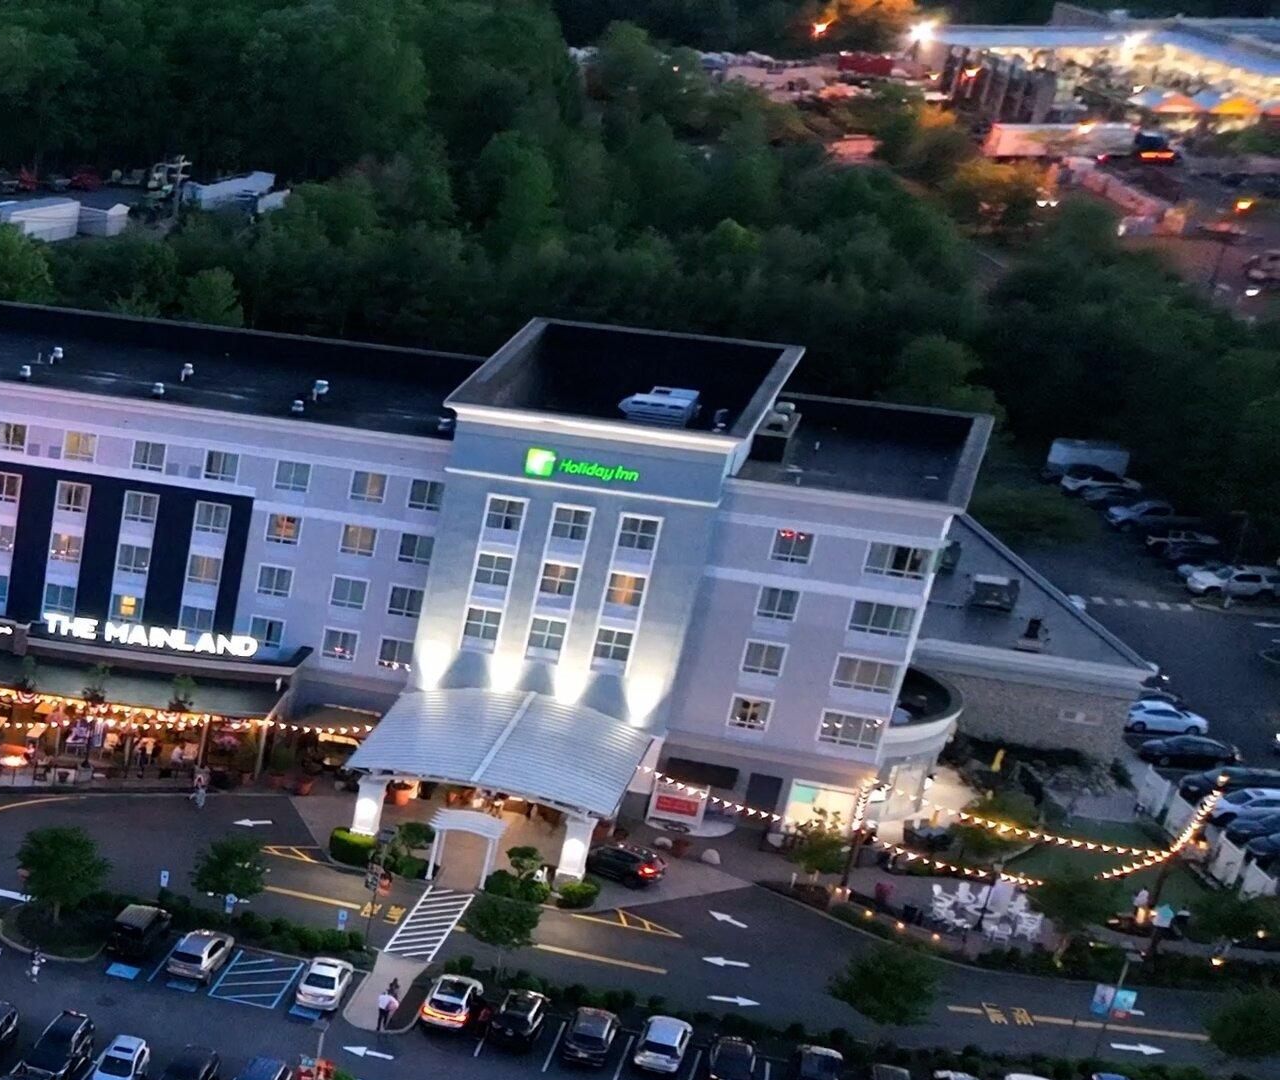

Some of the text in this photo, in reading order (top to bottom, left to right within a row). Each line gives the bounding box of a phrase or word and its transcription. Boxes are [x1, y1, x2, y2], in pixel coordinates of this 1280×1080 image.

[559, 459, 639, 482] Holiday Inn
[43, 612, 98, 640] THE
[104, 621, 259, 657] MAINLAND
